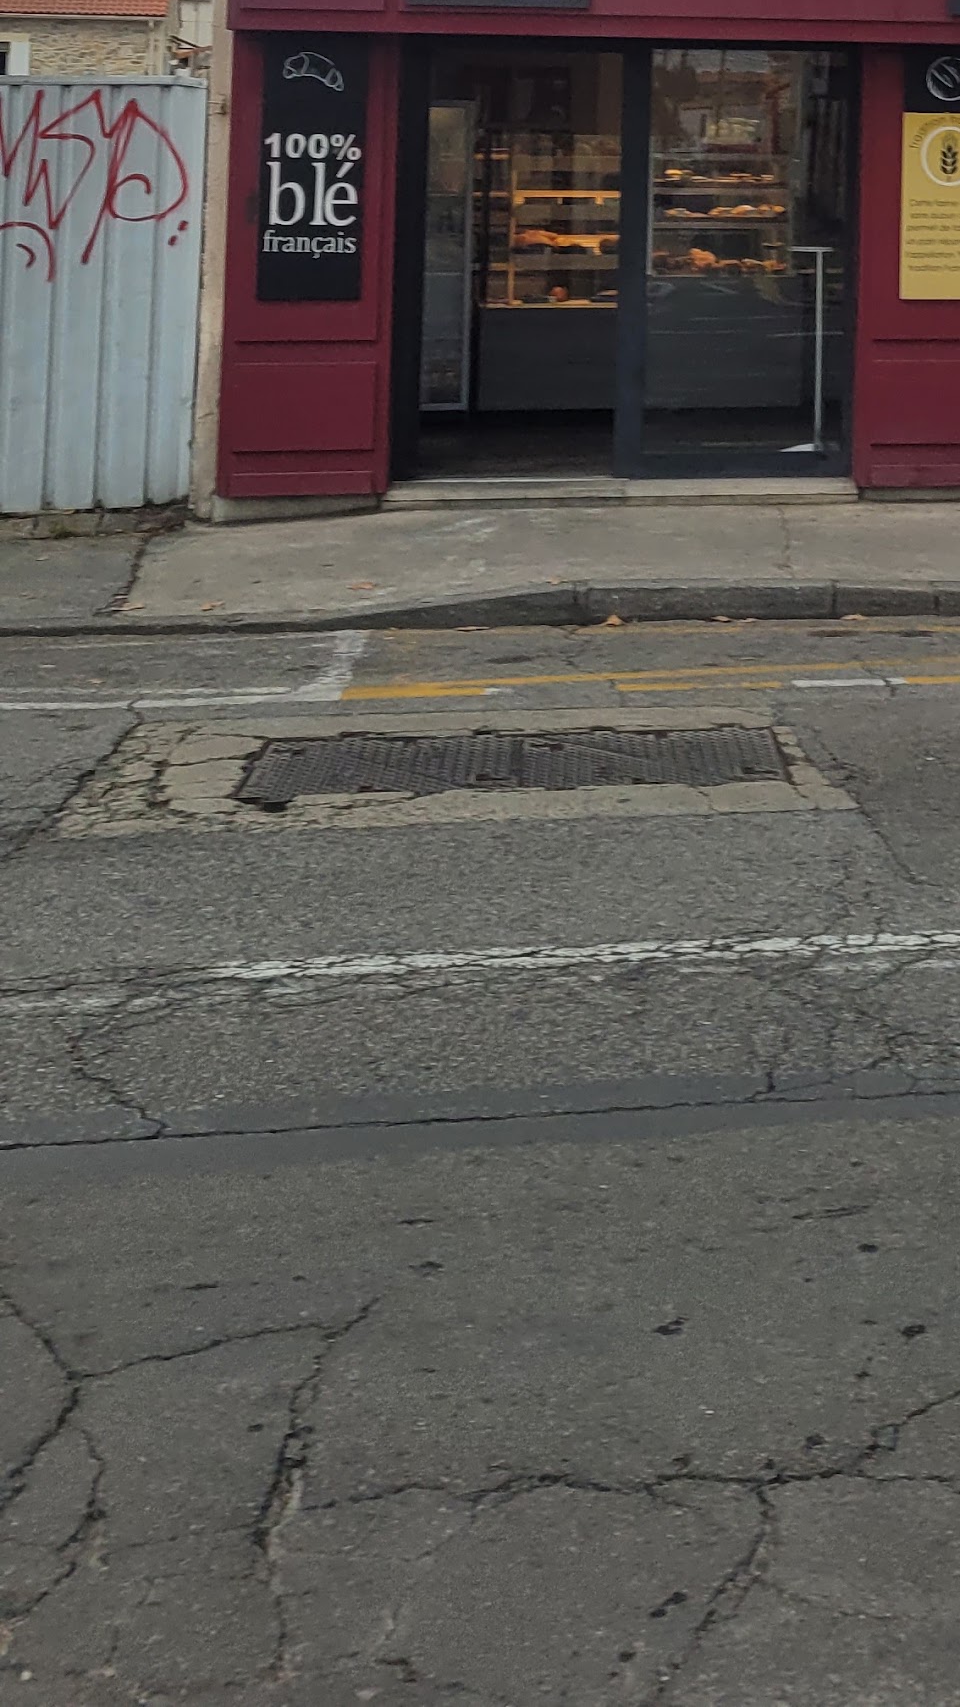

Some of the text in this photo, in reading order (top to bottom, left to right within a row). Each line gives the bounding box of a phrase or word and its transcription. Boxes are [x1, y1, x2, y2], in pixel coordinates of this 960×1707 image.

[264, 132, 362, 161] 100%
[265, 161, 358, 227] blé
[262, 229, 357, 259] français
